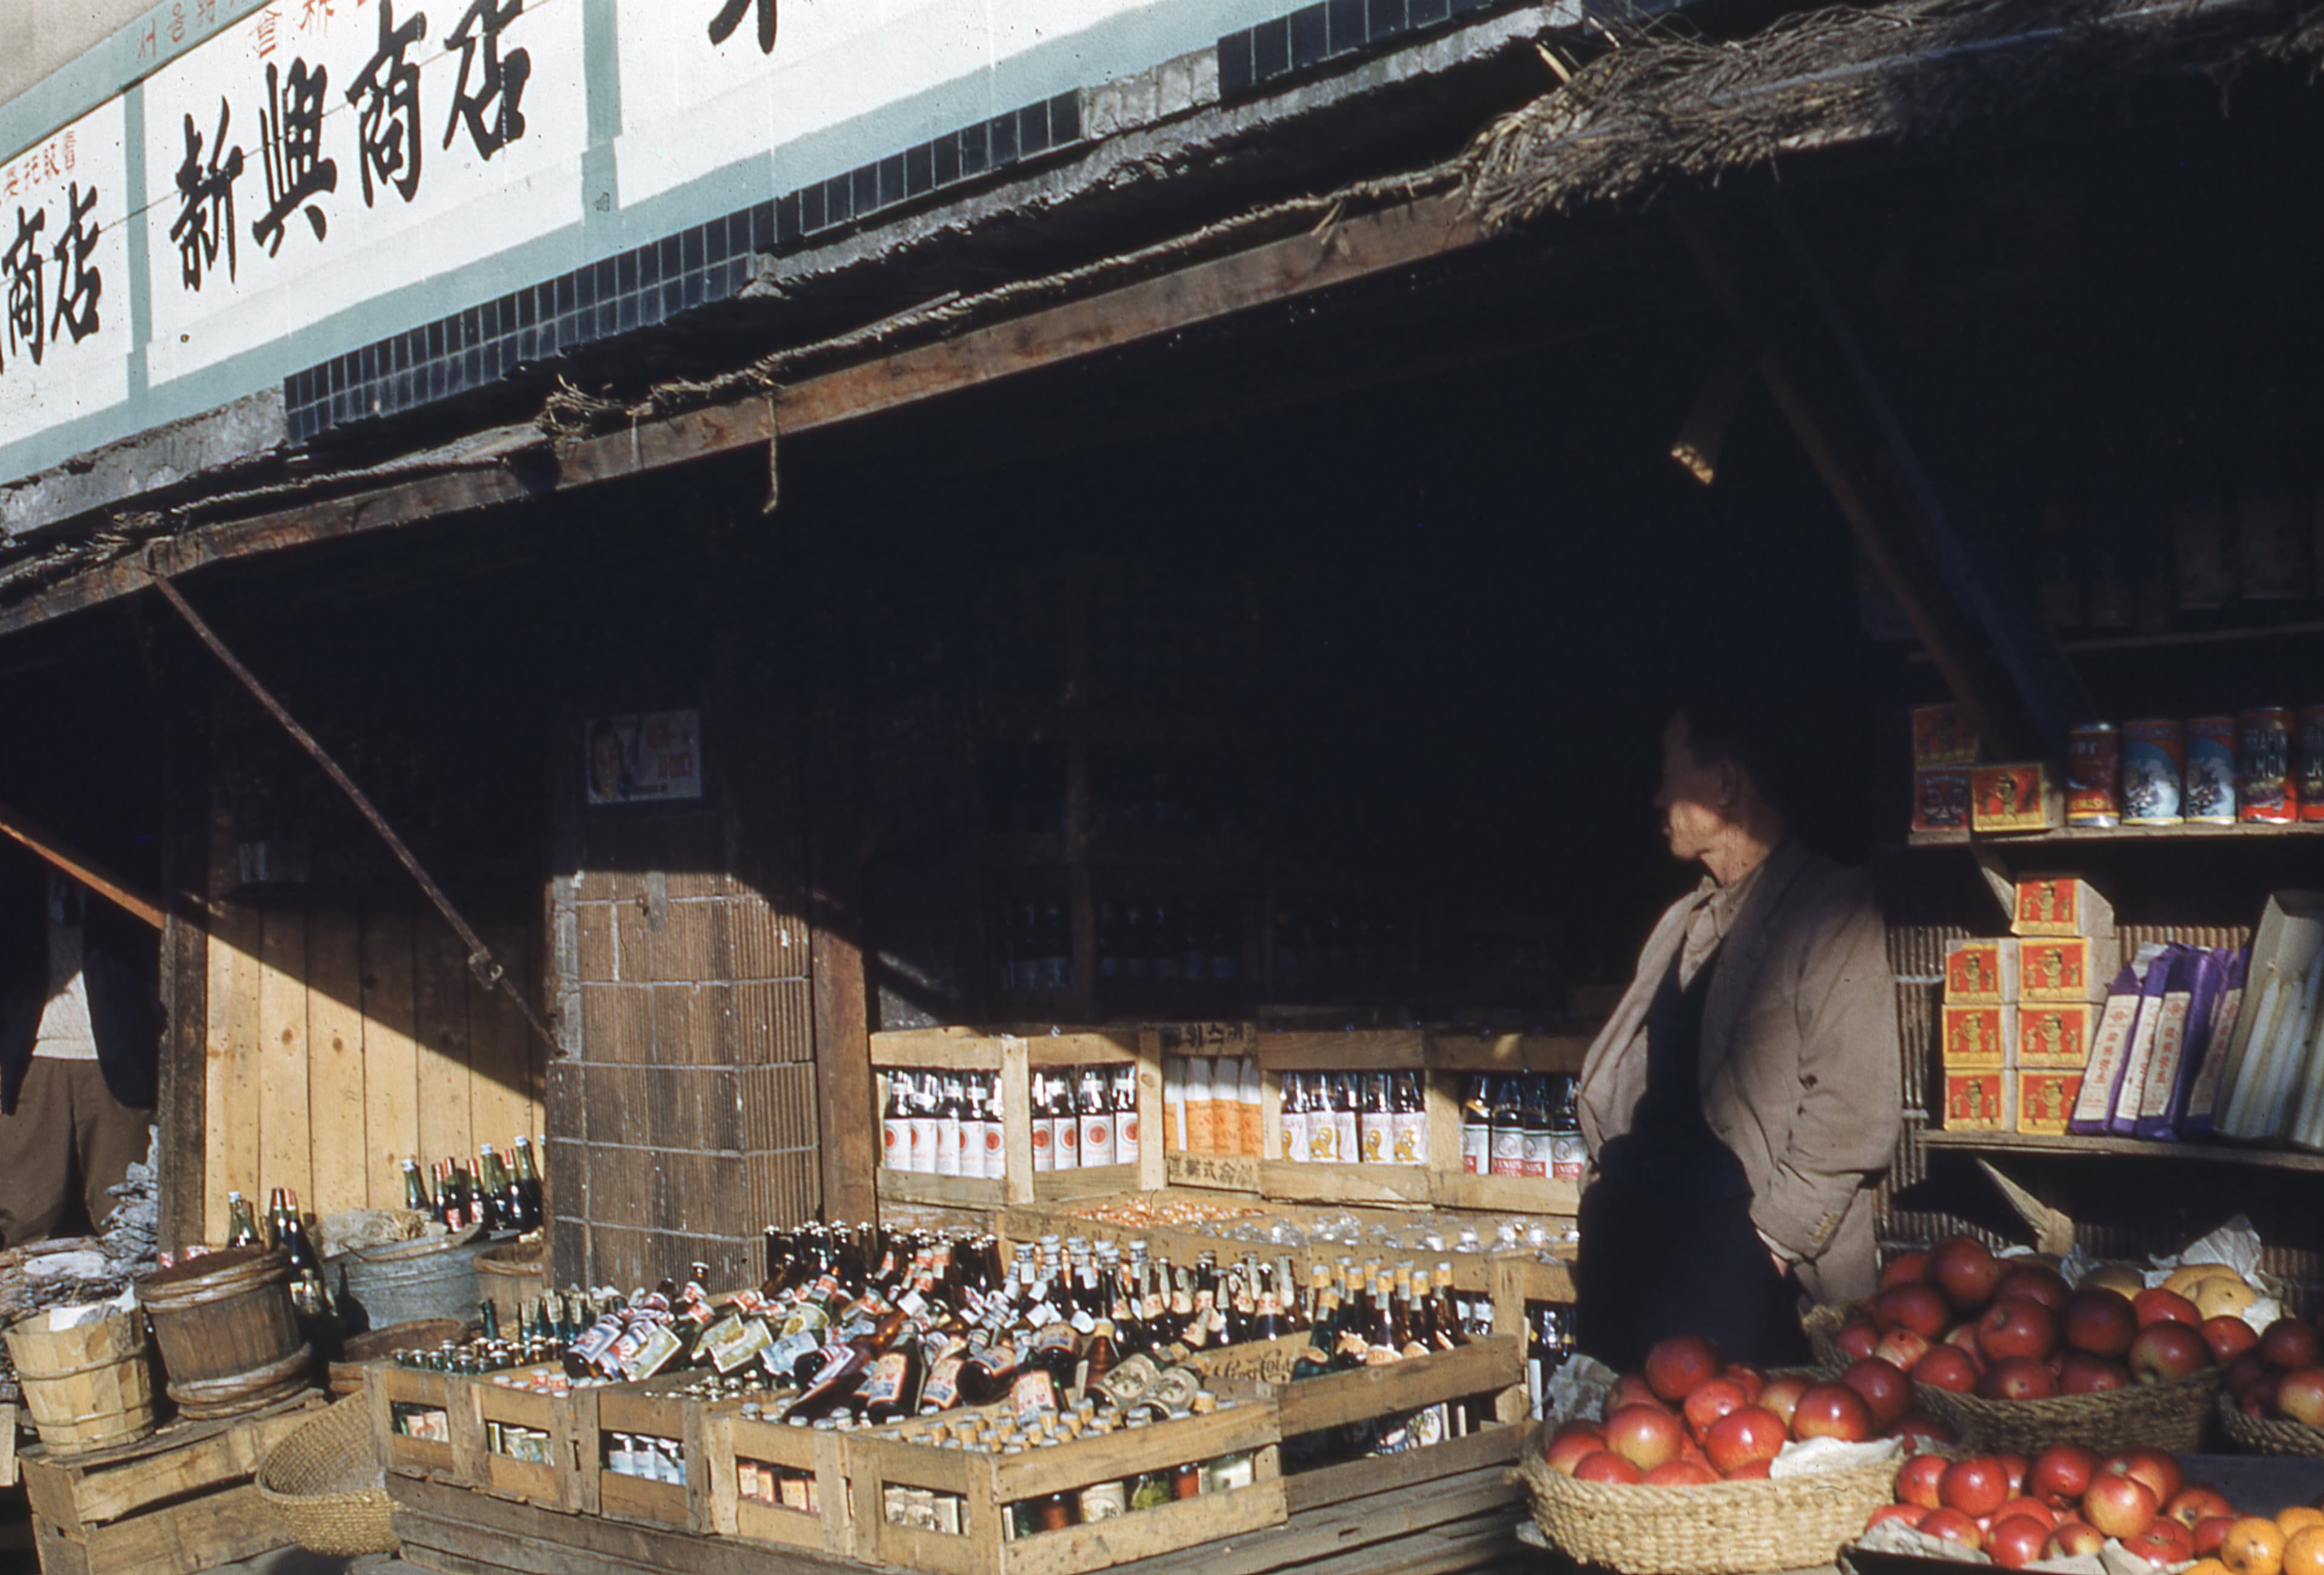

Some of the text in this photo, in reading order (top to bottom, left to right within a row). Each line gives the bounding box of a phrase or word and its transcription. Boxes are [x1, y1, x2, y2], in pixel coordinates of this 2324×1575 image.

[169, 0, 531, 292] 新興商店
[0, 181, 102, 376] 商店
